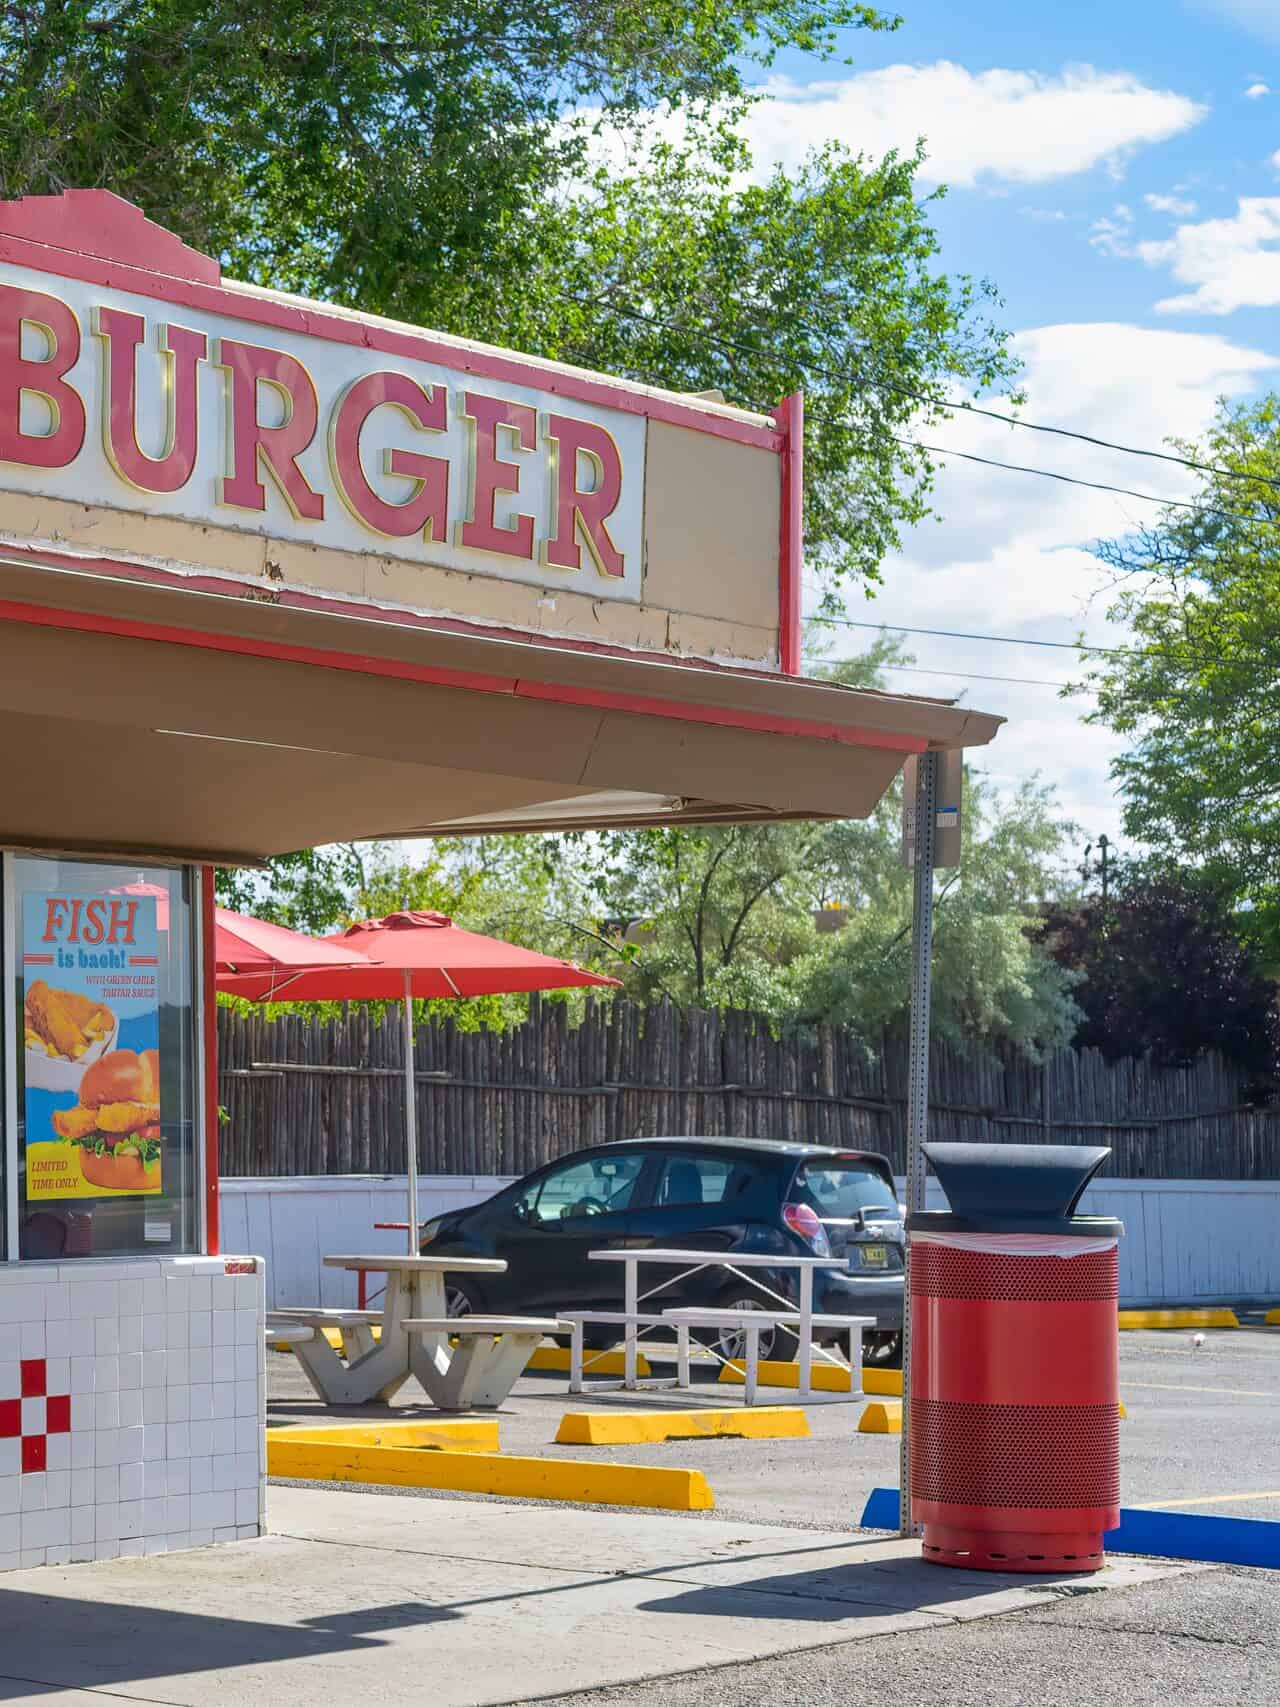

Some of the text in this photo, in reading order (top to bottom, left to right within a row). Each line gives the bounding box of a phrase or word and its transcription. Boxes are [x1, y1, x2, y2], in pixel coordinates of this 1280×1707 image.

[41, 898, 139, 945] FISH
[57, 948, 126, 968] is back!
[31, 1160, 68, 1172] LIMITED
[31, 1177, 79, 1190] TIME ONLY
